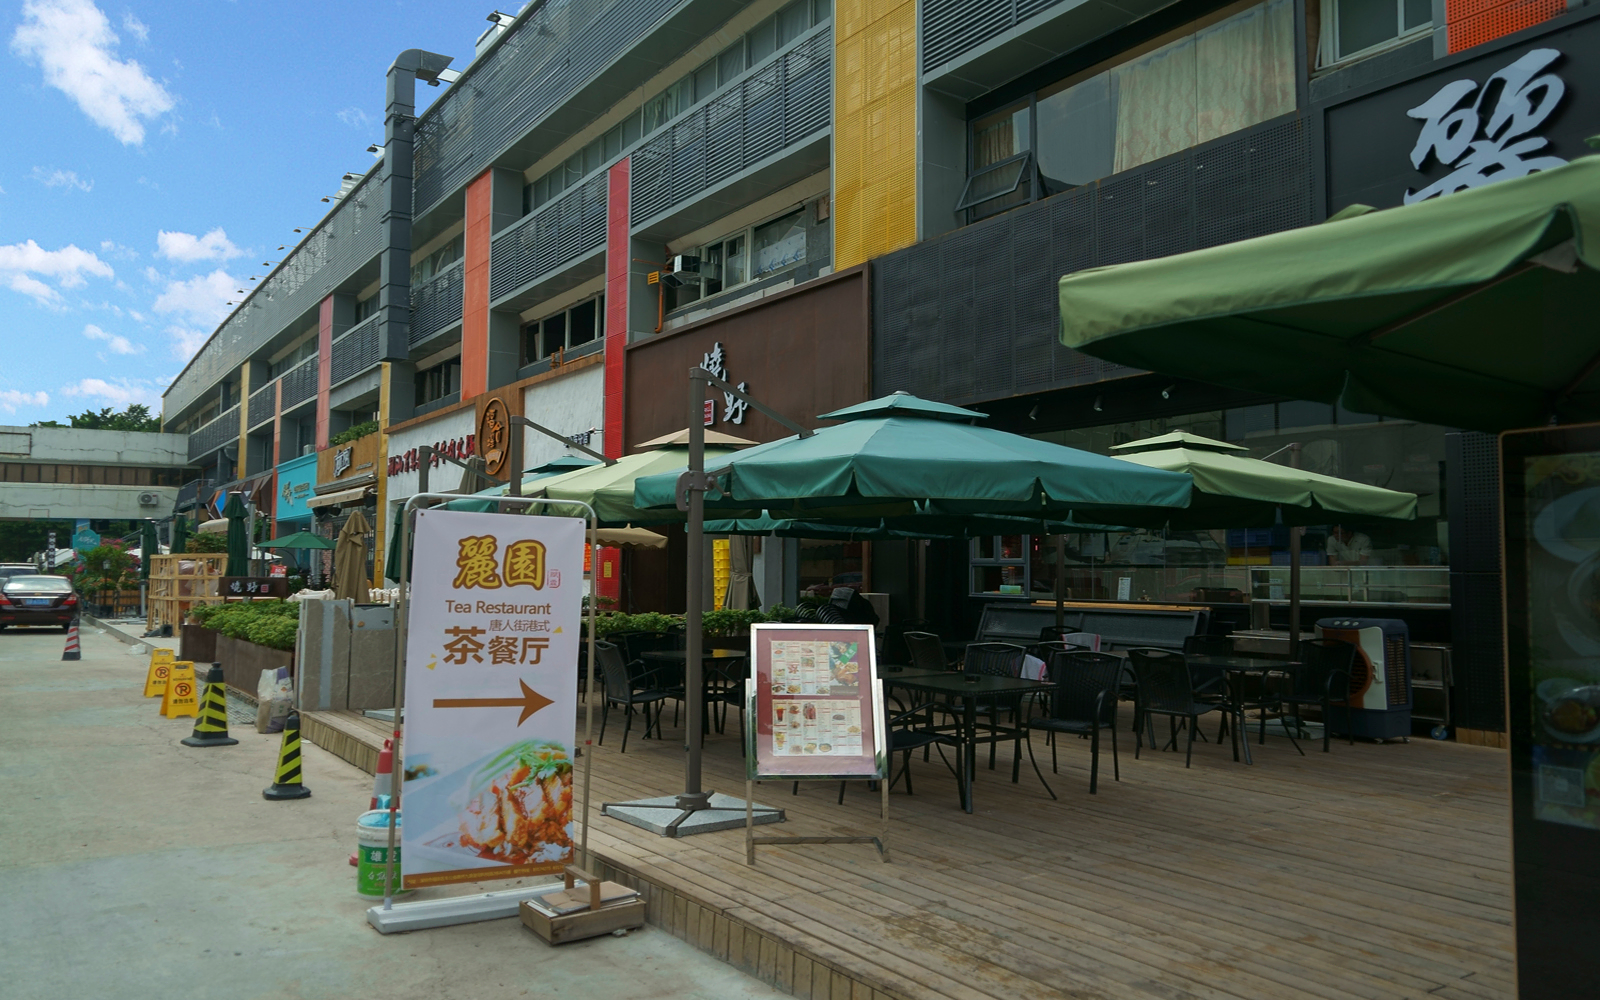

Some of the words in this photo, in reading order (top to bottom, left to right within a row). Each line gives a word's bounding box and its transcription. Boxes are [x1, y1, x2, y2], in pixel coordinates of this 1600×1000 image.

[445, 600, 471, 614] Tea
[476, 600, 551, 615] Restaurant
[488, 619, 550, 632] 唐人街港式
[443, 626, 550, 666] 茶餐厅
